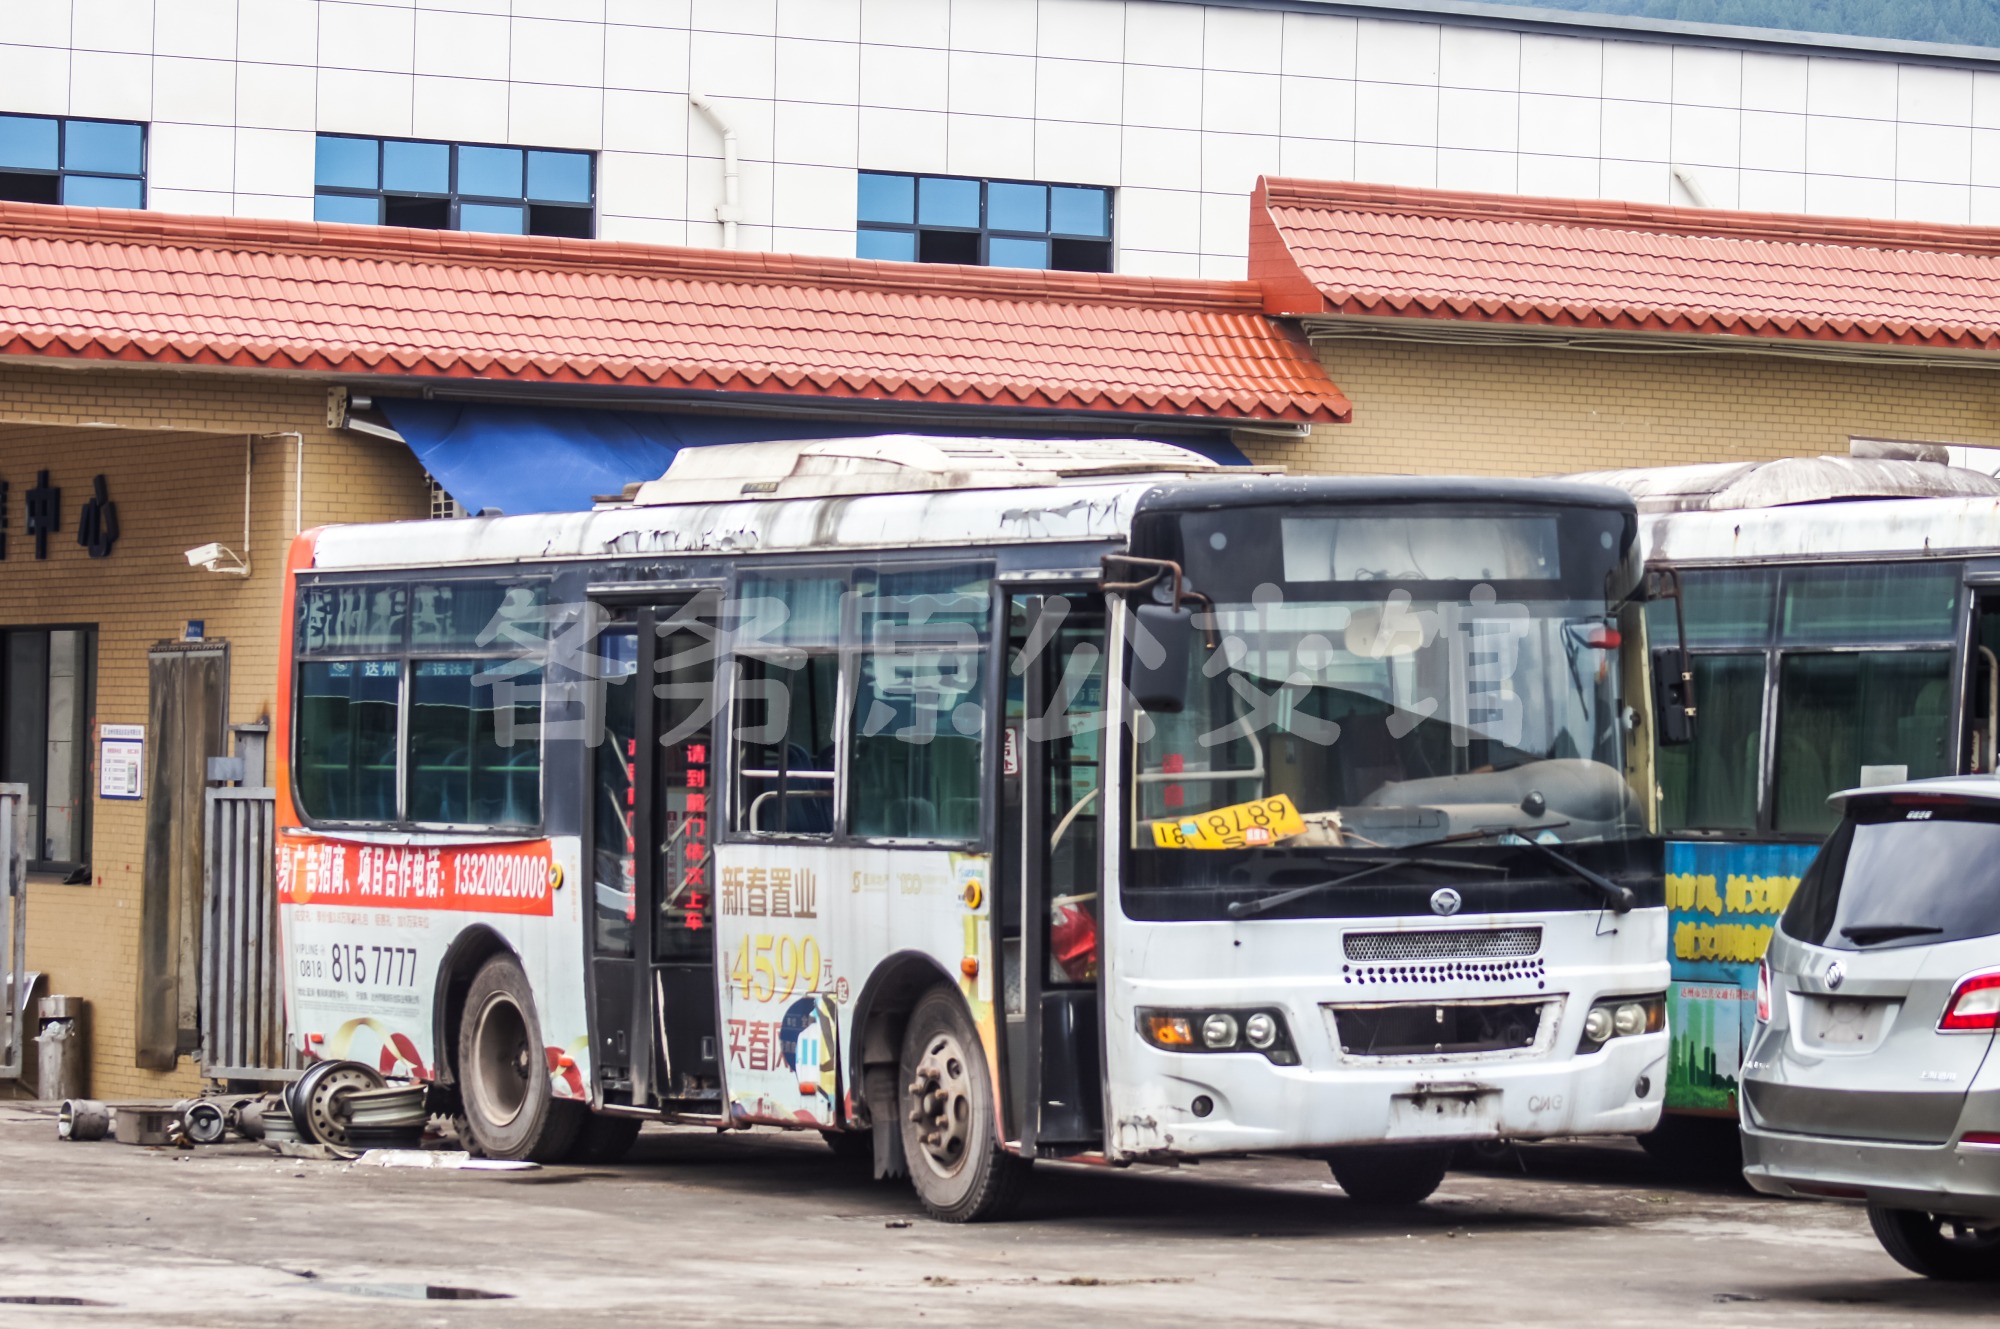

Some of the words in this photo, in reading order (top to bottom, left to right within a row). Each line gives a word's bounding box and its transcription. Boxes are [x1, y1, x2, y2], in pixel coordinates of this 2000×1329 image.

[0, 469, 120, 560] 中心
[684, 744, 706, 931] 请到前门依次上车
[722, 865, 817, 919] 新春置业
[332, 943, 366, 984] 815
[372, 946, 417, 987] 7777
[731, 933, 821, 1004] 4599
